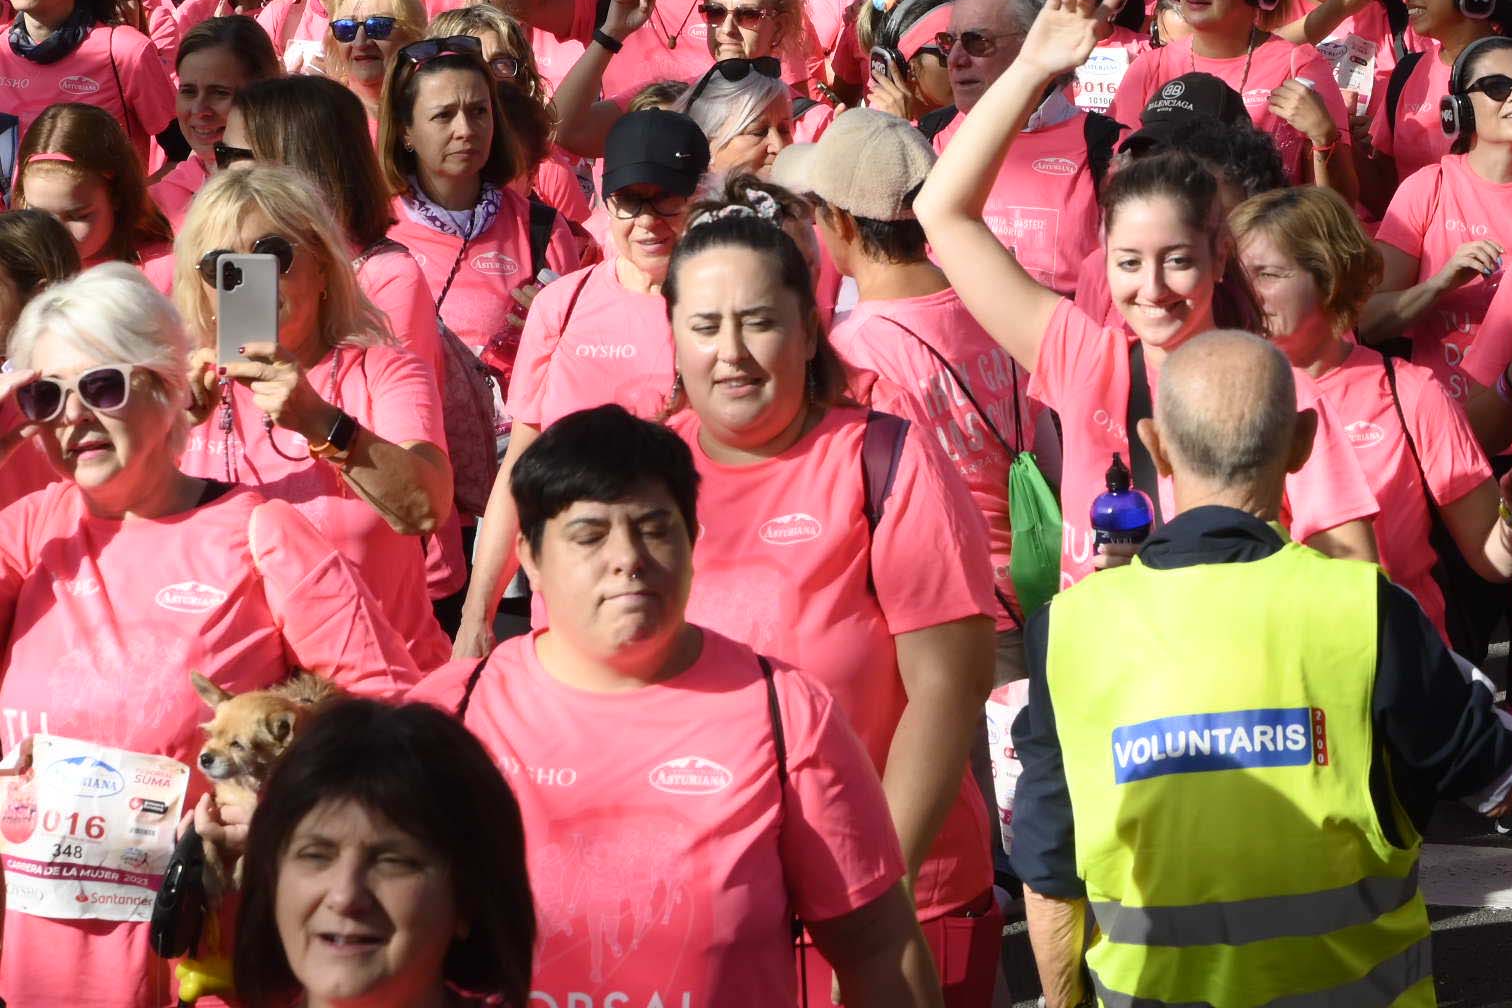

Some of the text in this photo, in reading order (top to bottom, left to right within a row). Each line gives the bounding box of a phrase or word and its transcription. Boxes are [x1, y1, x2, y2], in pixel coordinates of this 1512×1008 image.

[1147, 98, 1194, 112] BALENCIAGA
[575, 343, 636, 360] OYSHO
[1114, 722, 1306, 767] VOLUNTARIS
[1316, 708, 1326, 766] 2000
[53, 843, 83, 860] 348
[43, 865, 58, 878] DE
[60, 867, 77, 879] LA
[80, 869, 119, 882] MUJER
[90, 892, 153, 907] Santander
